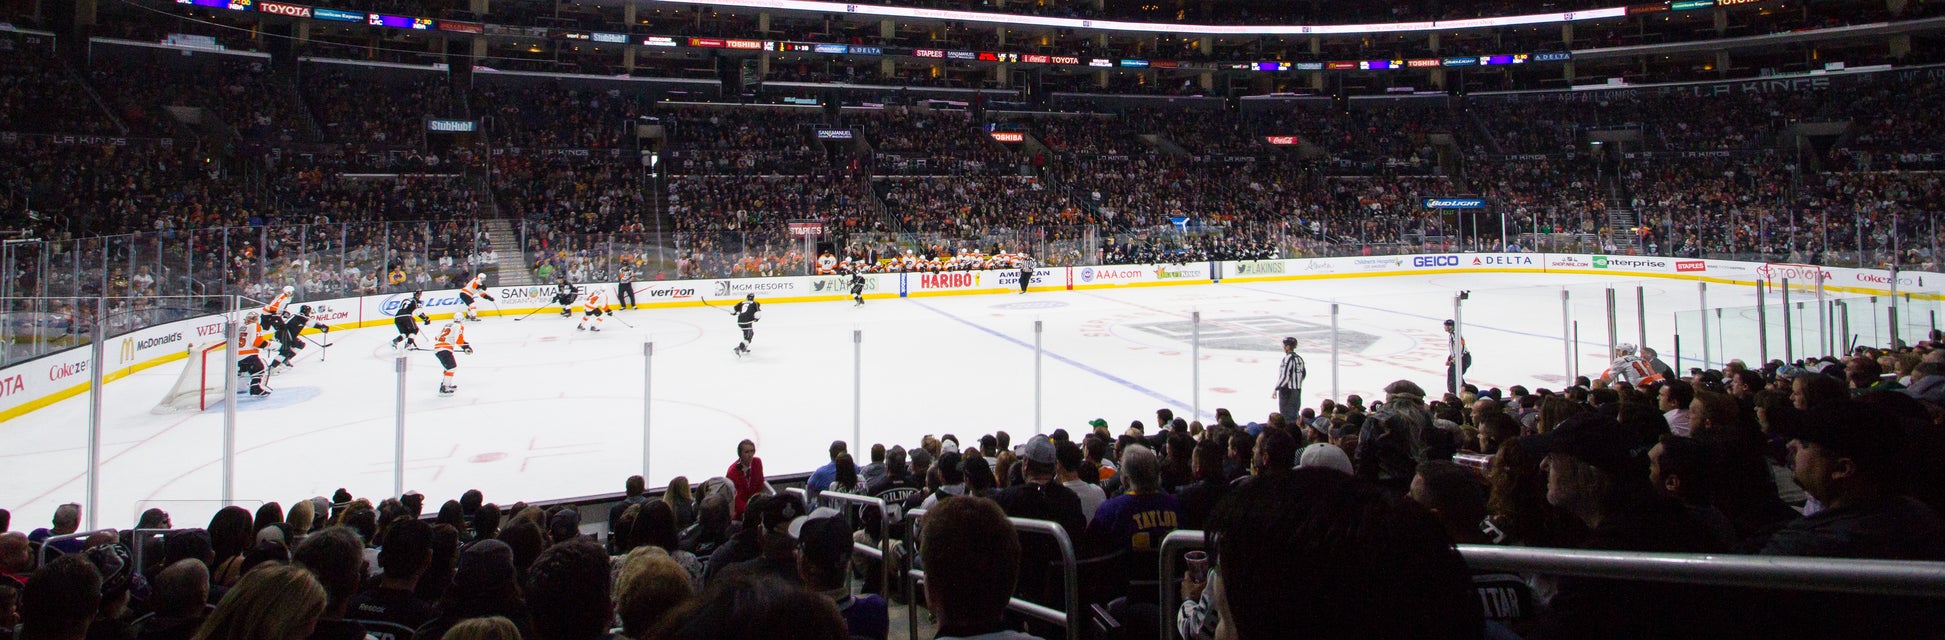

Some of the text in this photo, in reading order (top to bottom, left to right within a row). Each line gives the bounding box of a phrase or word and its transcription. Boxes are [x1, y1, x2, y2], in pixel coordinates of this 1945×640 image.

[261, 2, 311, 18] TOYOTA
[593, 33, 626, 43] StubHub!
[727, 41, 761, 49] TOSHIBA
[917, 50, 943, 58] STAPLES
[431, 120, 473, 131] StubHub!
[53, 135, 127, 146] LA KINGS
[790, 226, 822, 235] STAPLES
[1413, 255, 1459, 268] GEICO
[1486, 256, 1532, 265] DELTA
[1597, 258, 1665, 269] enterprise
[1246, 262, 1282, 275] #LAKINGS
[1096, 269, 1142, 280] AAA.com
[755, 282, 794, 290] RESORTS
[921, 273, 972, 289] HARIBO
[999, 277, 1042, 285] EXPSS
[501, 286, 588, 299] SAN MAEL
[650, 286, 695, 299] verizon
[136, 332, 183, 351] McDonald's
[1132, 509, 1179, 530] TAYLOR
[358, 602, 386, 614] Reebok
